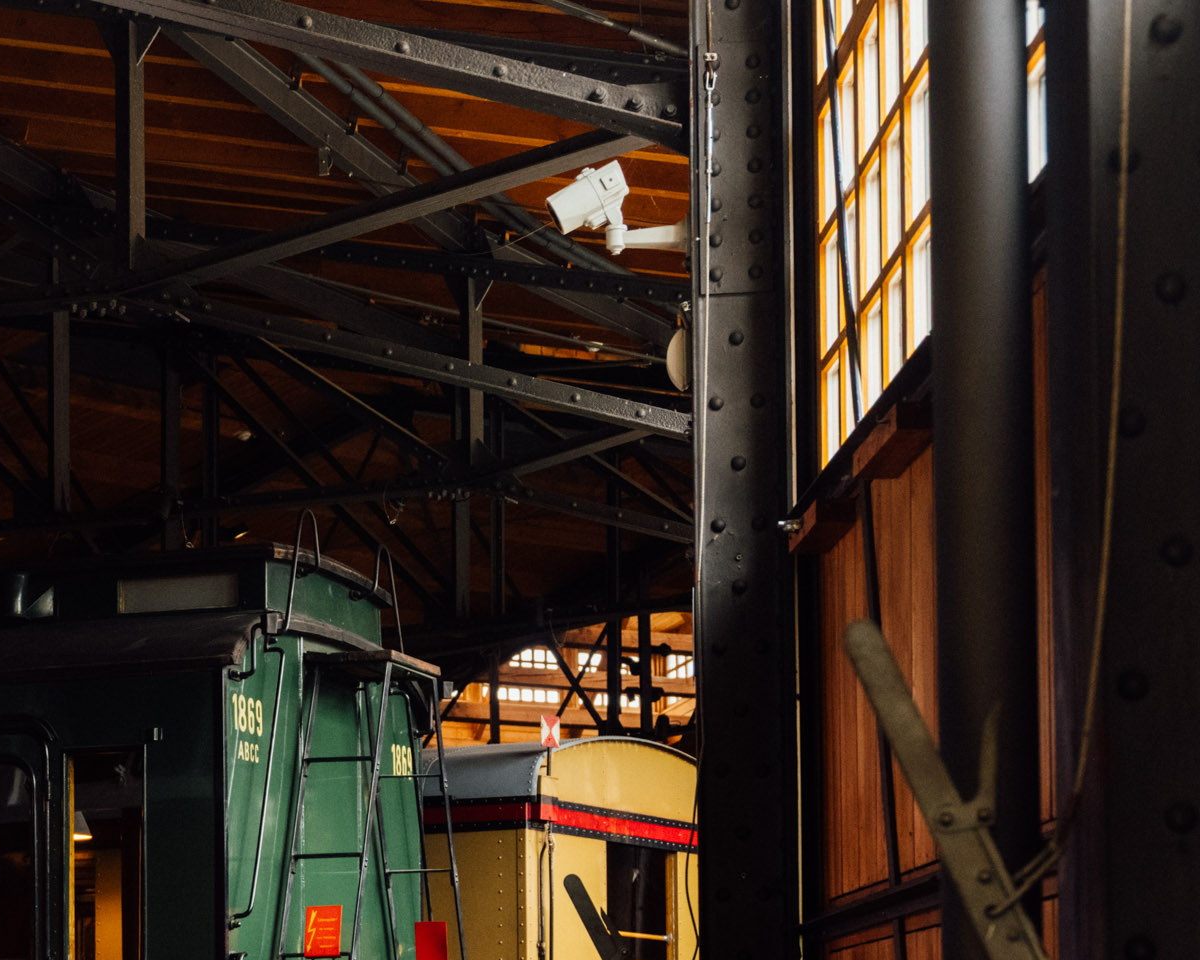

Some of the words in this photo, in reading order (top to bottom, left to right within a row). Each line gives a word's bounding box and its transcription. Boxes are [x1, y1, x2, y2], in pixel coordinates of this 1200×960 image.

[231, 693, 263, 737] 1869
[237, 740, 259, 763] ABCC
[391, 743, 413, 781] 1869
